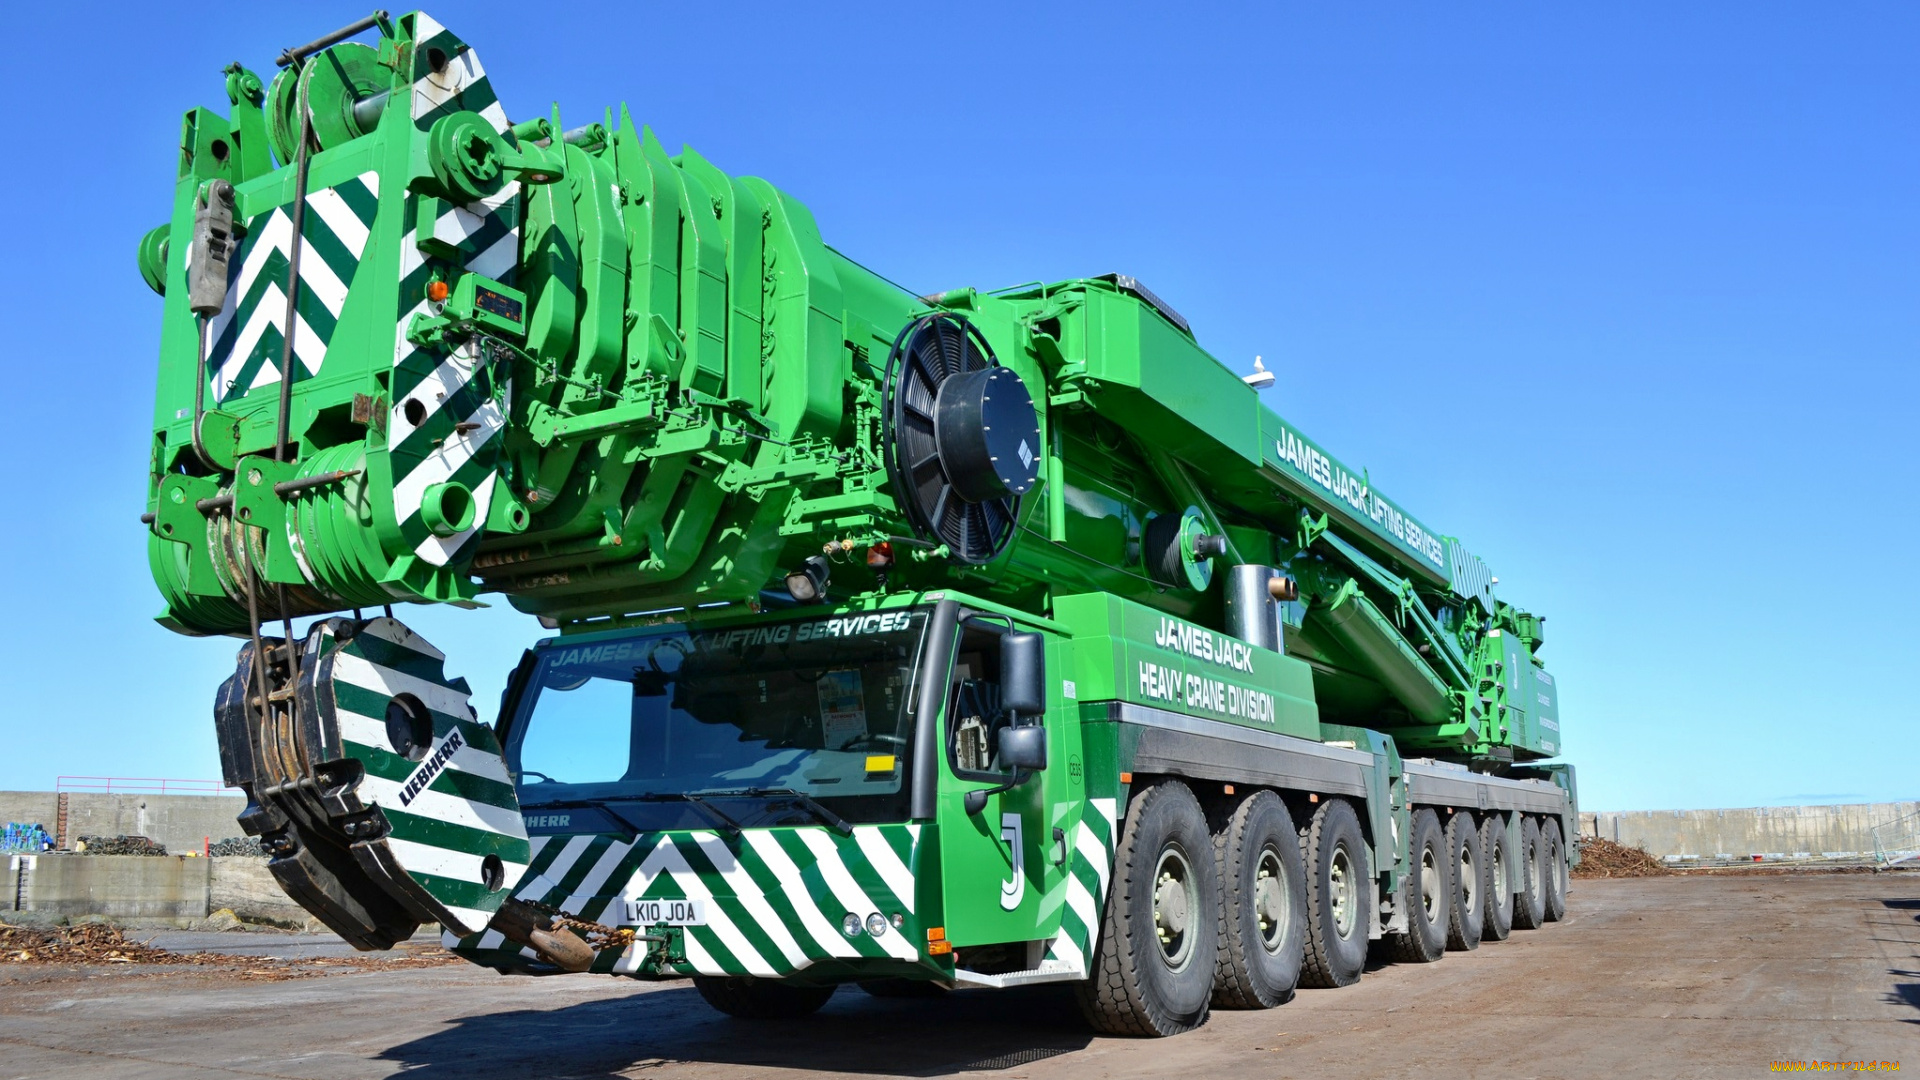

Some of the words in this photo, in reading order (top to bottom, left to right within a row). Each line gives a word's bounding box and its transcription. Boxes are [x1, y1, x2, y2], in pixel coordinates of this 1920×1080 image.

[1276, 427, 1332, 490] JAMES
[1332, 466, 1369, 516] JACK
[1369, 491, 1404, 540] LIFTING
[1404, 517, 1443, 568] SERVICES
[550, 642, 633, 668] JAMES
[711, 625, 791, 649] LIFTING
[795, 611, 911, 641] SERVICES
[1155, 616, 1214, 661] JAMES
[1214, 636, 1254, 674] JACK
[1139, 660, 1182, 703] HEAVY
[1185, 673, 1226, 713] CRANE
[1227, 684, 1275, 723] DIVISION
[398, 732, 463, 808] LIEBHERR
